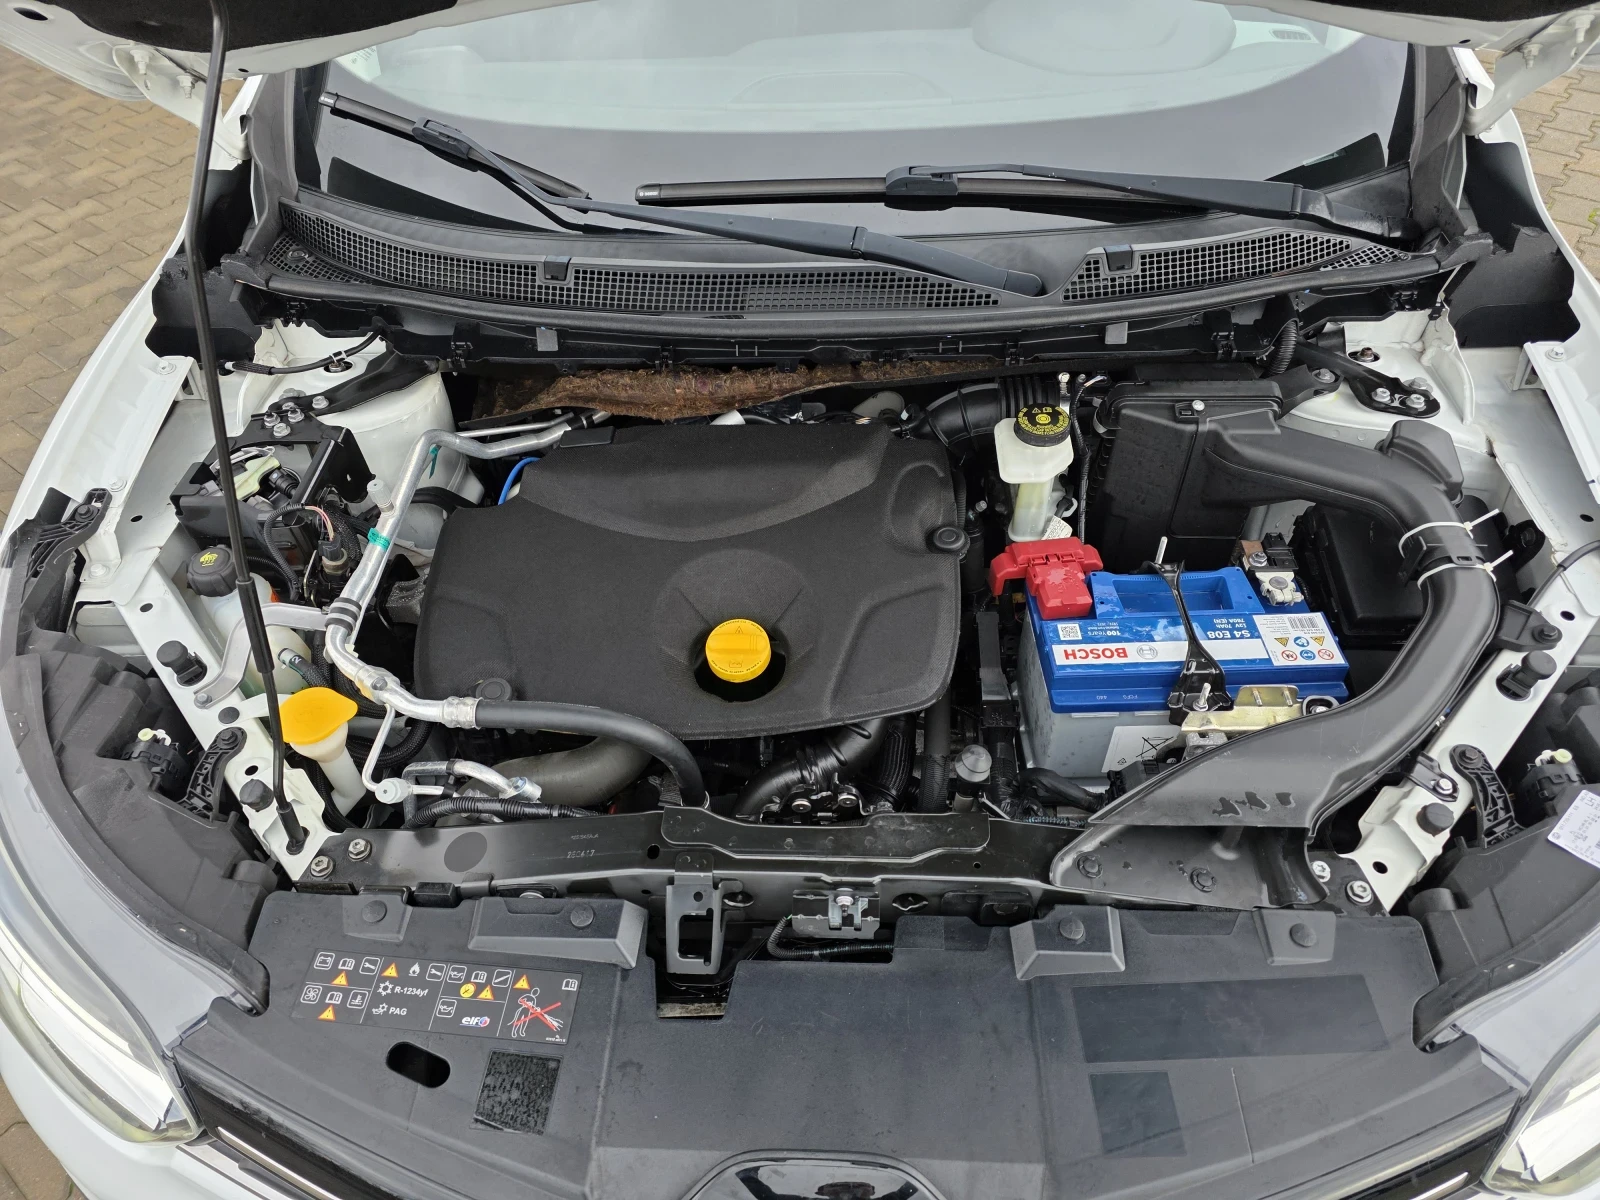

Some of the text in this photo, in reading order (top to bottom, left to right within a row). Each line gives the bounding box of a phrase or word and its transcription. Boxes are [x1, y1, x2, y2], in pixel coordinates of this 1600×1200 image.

[1207, 629, 1251, 639] S4 E08
[1063, 647, 1129, 660] BOSCH
[394, 986, 429, 997] R-1234yf
[388, 1006, 408, 1015] PAG
[461, 1016, 481, 1026] elf
